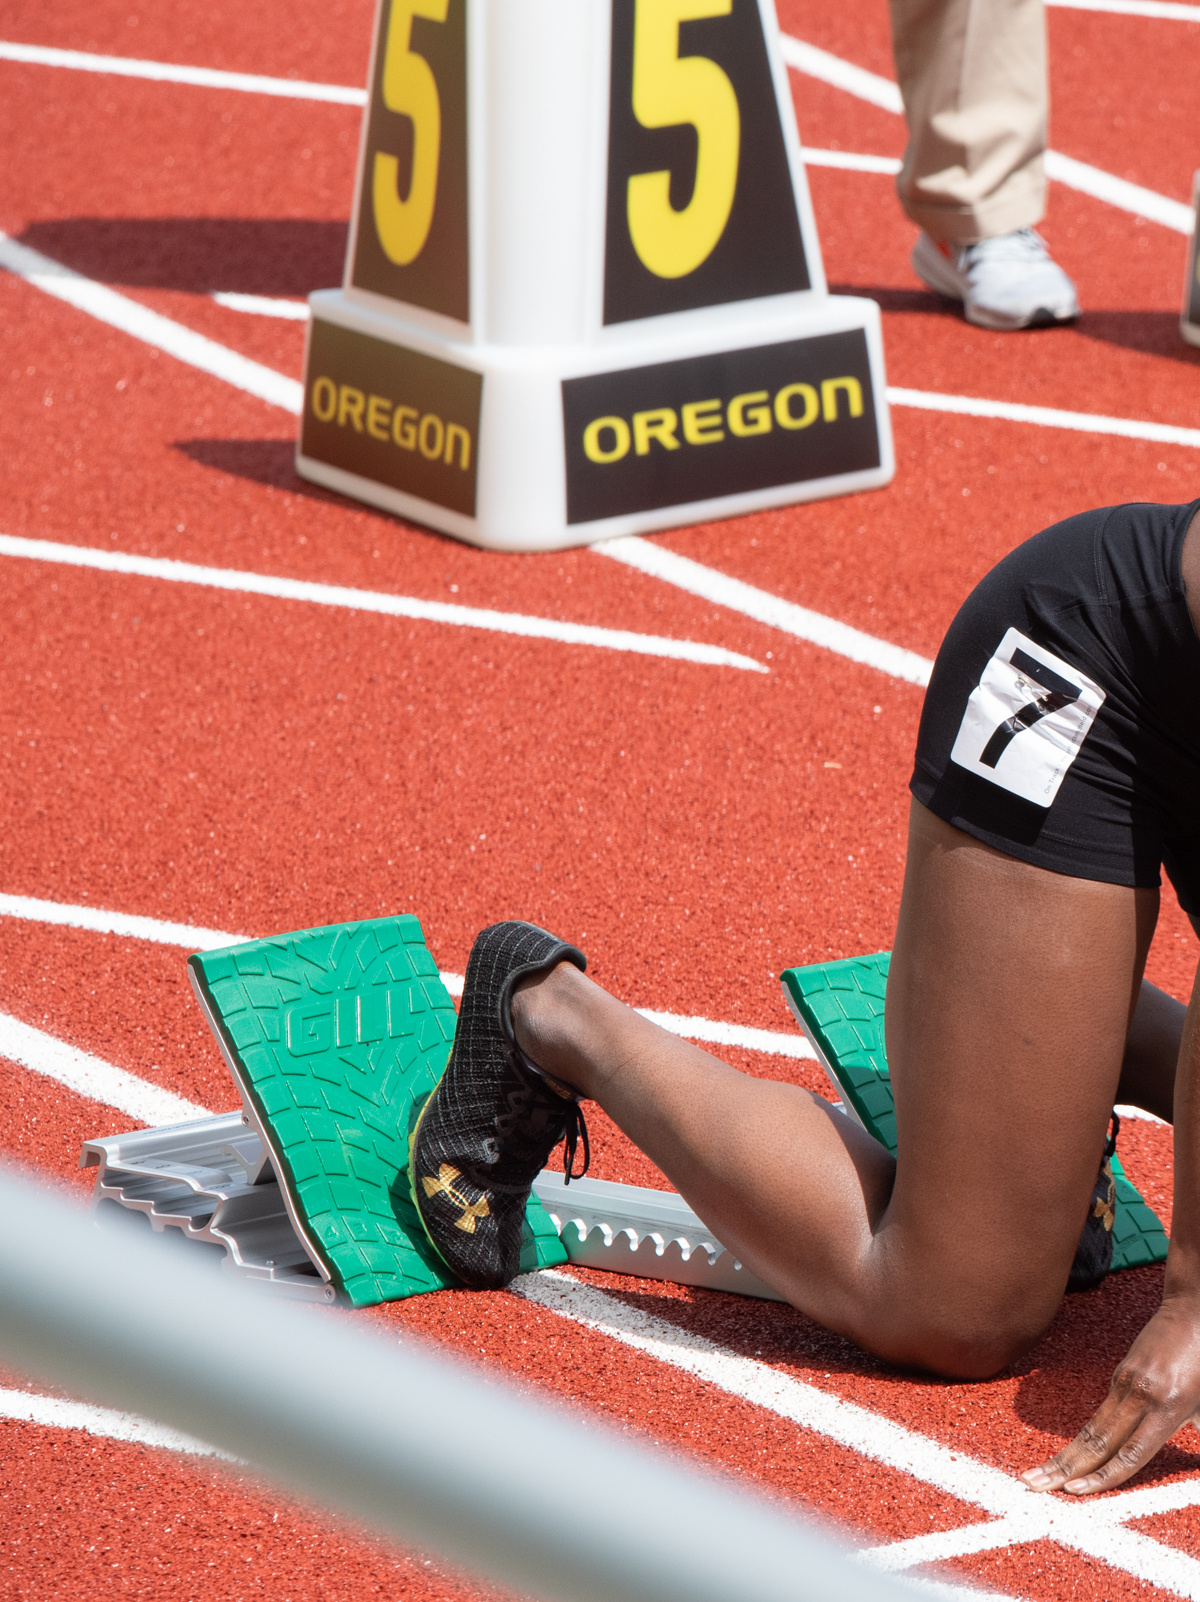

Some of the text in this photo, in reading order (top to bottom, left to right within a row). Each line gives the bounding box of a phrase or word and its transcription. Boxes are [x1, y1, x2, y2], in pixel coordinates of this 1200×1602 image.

[373, 0, 449, 266] 5
[627, 0, 740, 279] 5
[312, 375, 473, 471] OREGON
[583, 375, 864, 464] OREGON
[979, 647, 1082, 770] 7
[286, 988, 416, 1058] GILL
